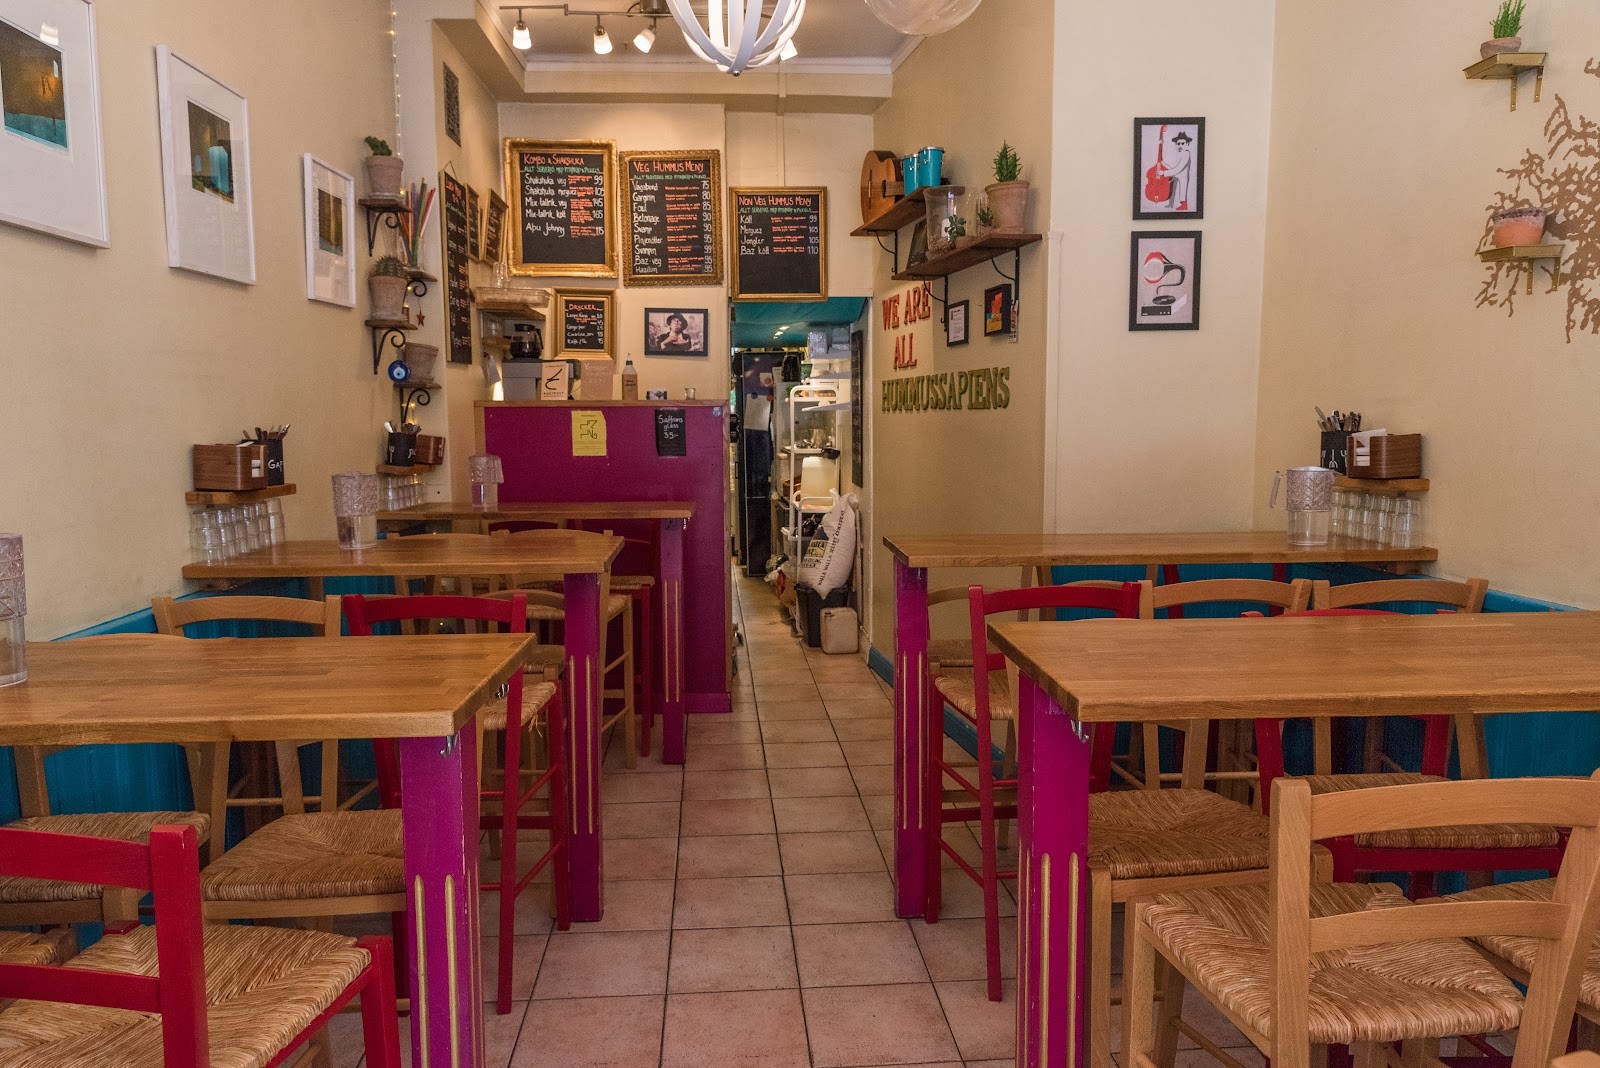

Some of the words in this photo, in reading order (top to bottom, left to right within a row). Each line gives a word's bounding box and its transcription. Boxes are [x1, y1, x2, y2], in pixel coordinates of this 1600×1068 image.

[633, 161, 649, 172] VEG
[653, 161, 684, 172] HUMMUS
[686, 161, 704, 173] MENY
[594, 175, 603, 185] 99
[701, 181, 709, 190] 75
[702, 191, 710, 200] 80
[703, 202, 711, 210] 85
[739, 196, 753, 205] NON
[754, 196, 766, 206] VEG
[768, 196, 793, 205] HUMMUS
[796, 196, 811, 206] MENY
[807, 246, 818, 254] 110
[882, 294, 899, 331] WE
[904, 281, 931, 325] ARE
[894, 333, 917, 370] ALL
